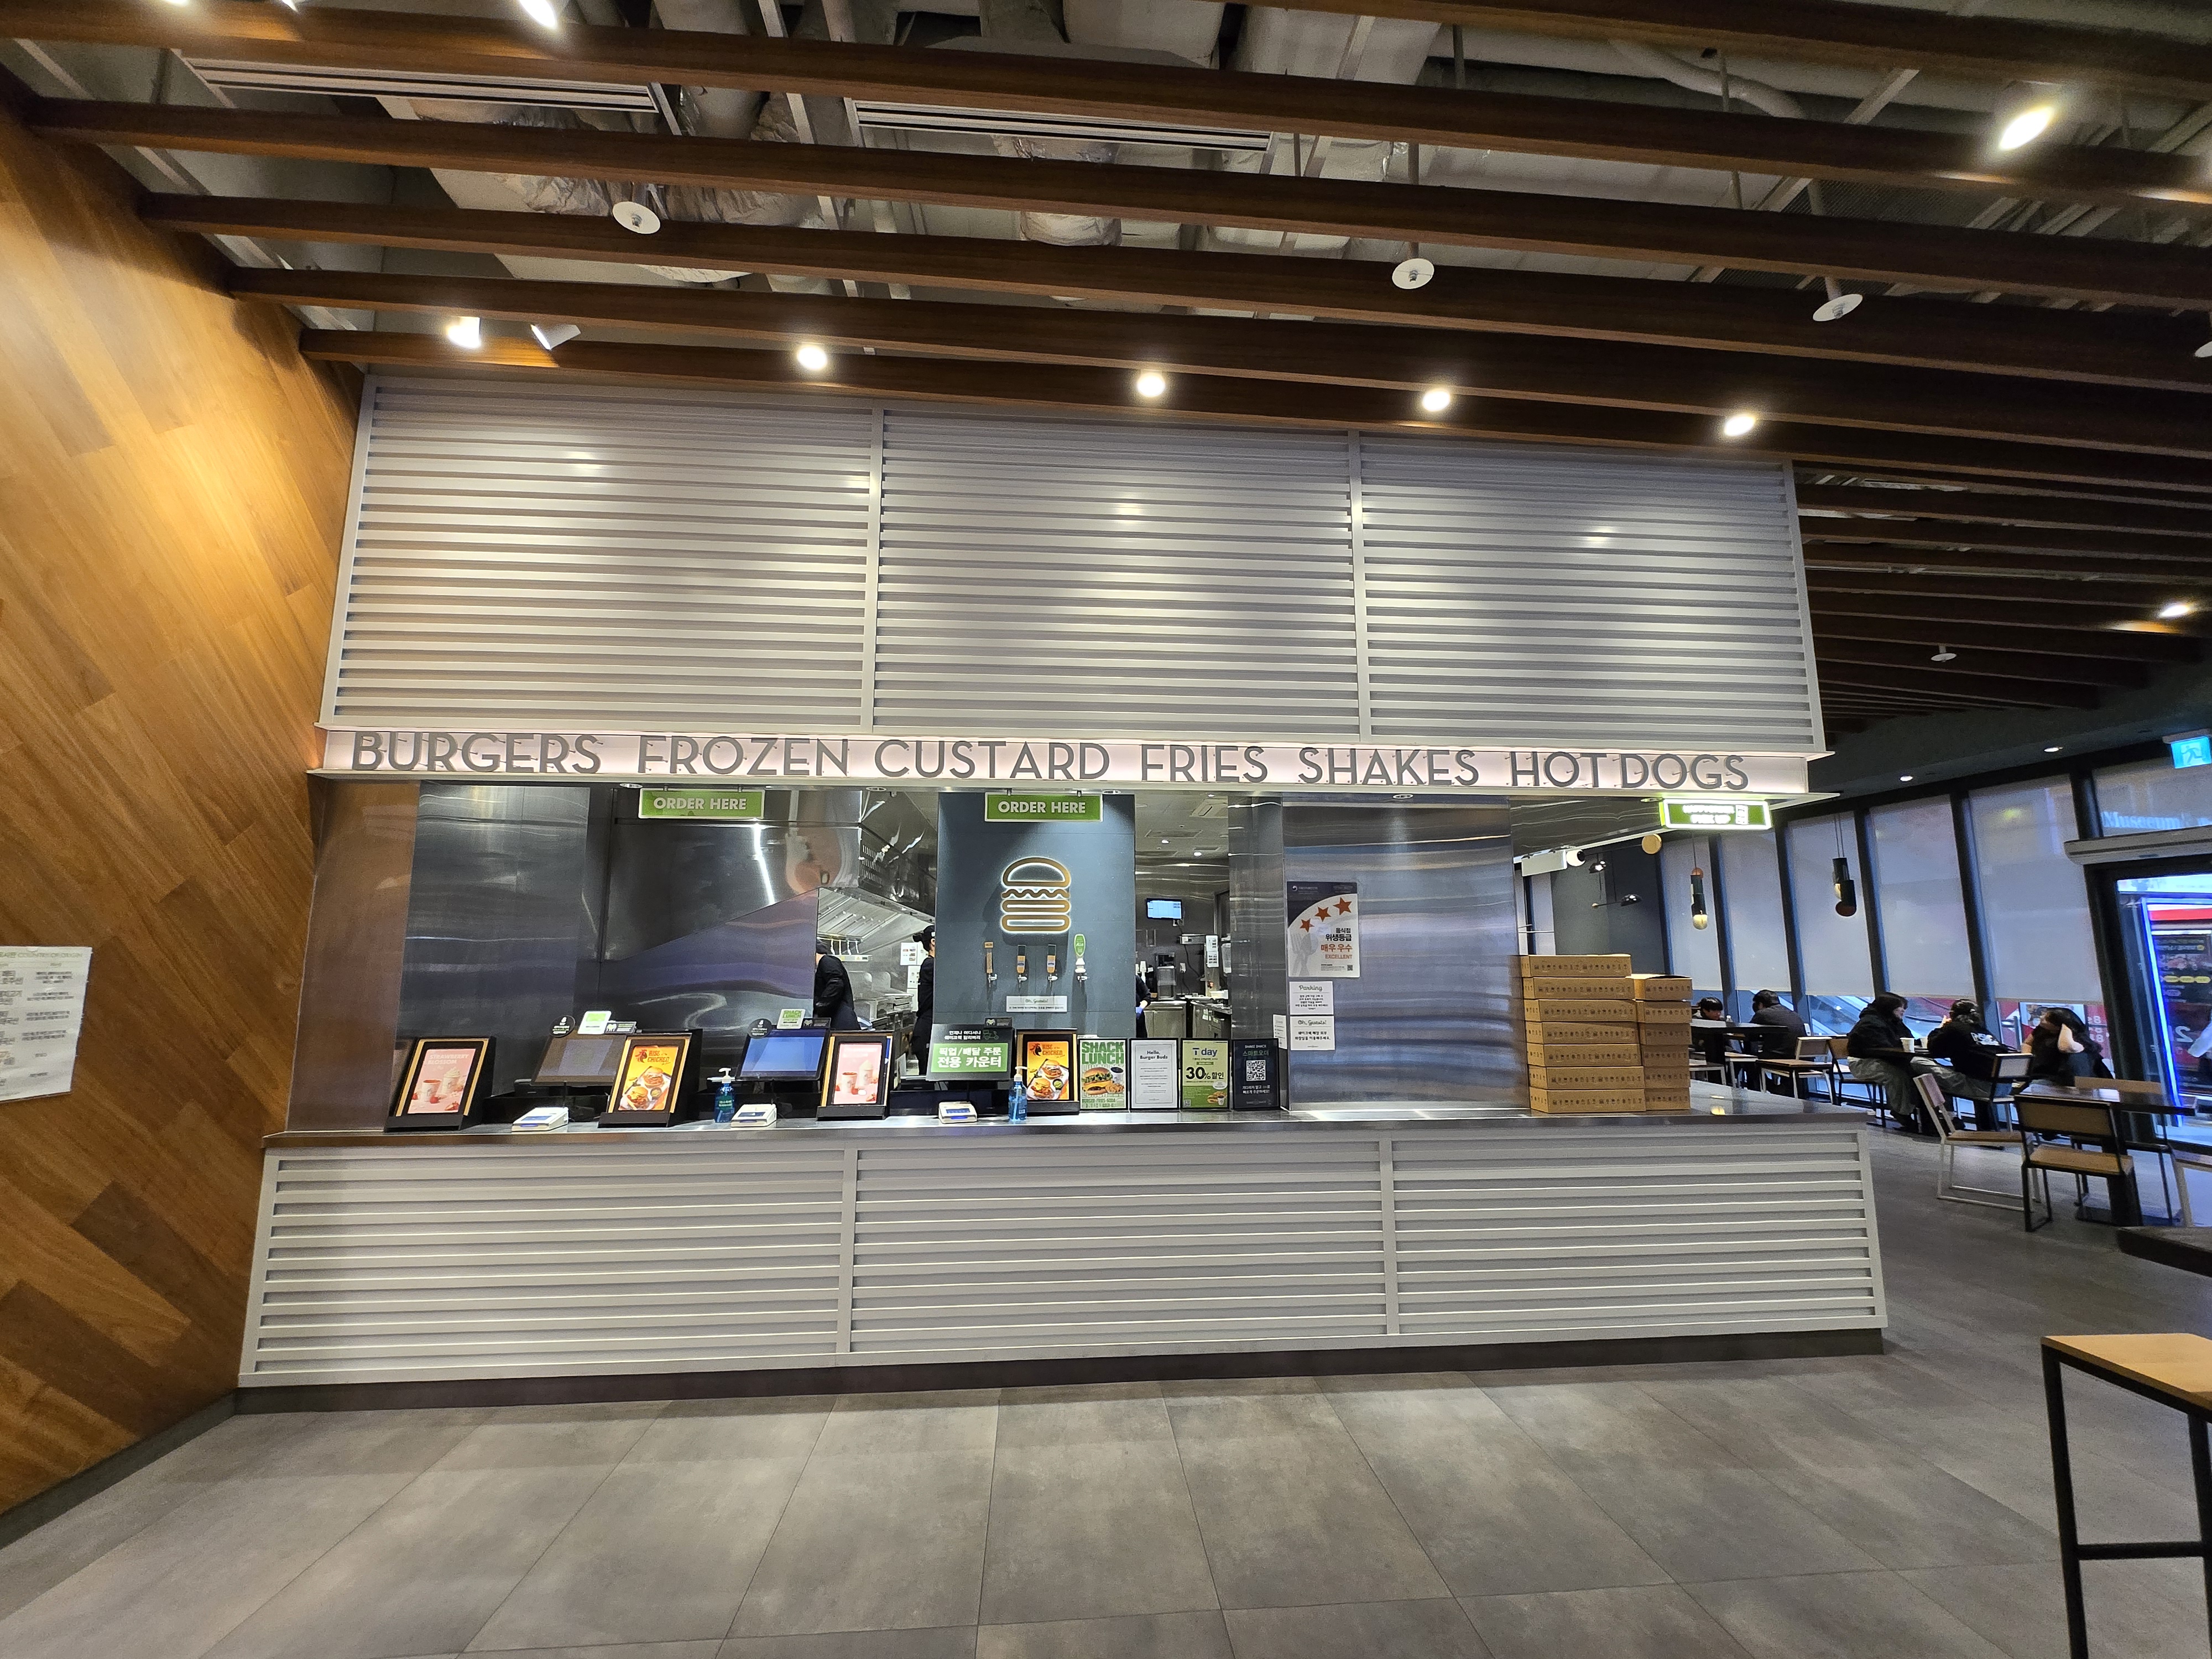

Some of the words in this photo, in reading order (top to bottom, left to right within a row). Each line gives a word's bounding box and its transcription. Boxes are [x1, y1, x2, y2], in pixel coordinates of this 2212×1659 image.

[352, 731, 601, 774] BURGERS
[638, 735, 848, 777] FROZEN
[874, 739, 1109, 780] CUSTARD
[1141, 744, 1267, 783] FRIES
[1298, 747, 1479, 785] SHAKES
[1511, 751, 1607, 788] HOT
[1620, 753, 1749, 790] DOGS
[654, 797, 705, 810] ORDER
[709, 798, 747, 810] HERE
[998, 801, 1046, 813] ORDER
[1051, 802, 1086, 813] HERE
[1326, 933, 1352, 942] 위생등급
[1321, 944, 1336, 952] 매우
[1337, 944, 1353, 952] 우수
[939, 1047, 981, 1056] 픽업/배달
[983, 1047, 1002, 1056] 주문
[1082, 1041, 1124, 1053] SHACK
[1201, 1048, 1218, 1057] day
[937, 1056, 962, 1068] 전용
[966, 1056, 1001, 1068] 카운터
[1082, 1053, 1124, 1064] LUNCH
[1186, 1066, 1211, 1079] 30%
